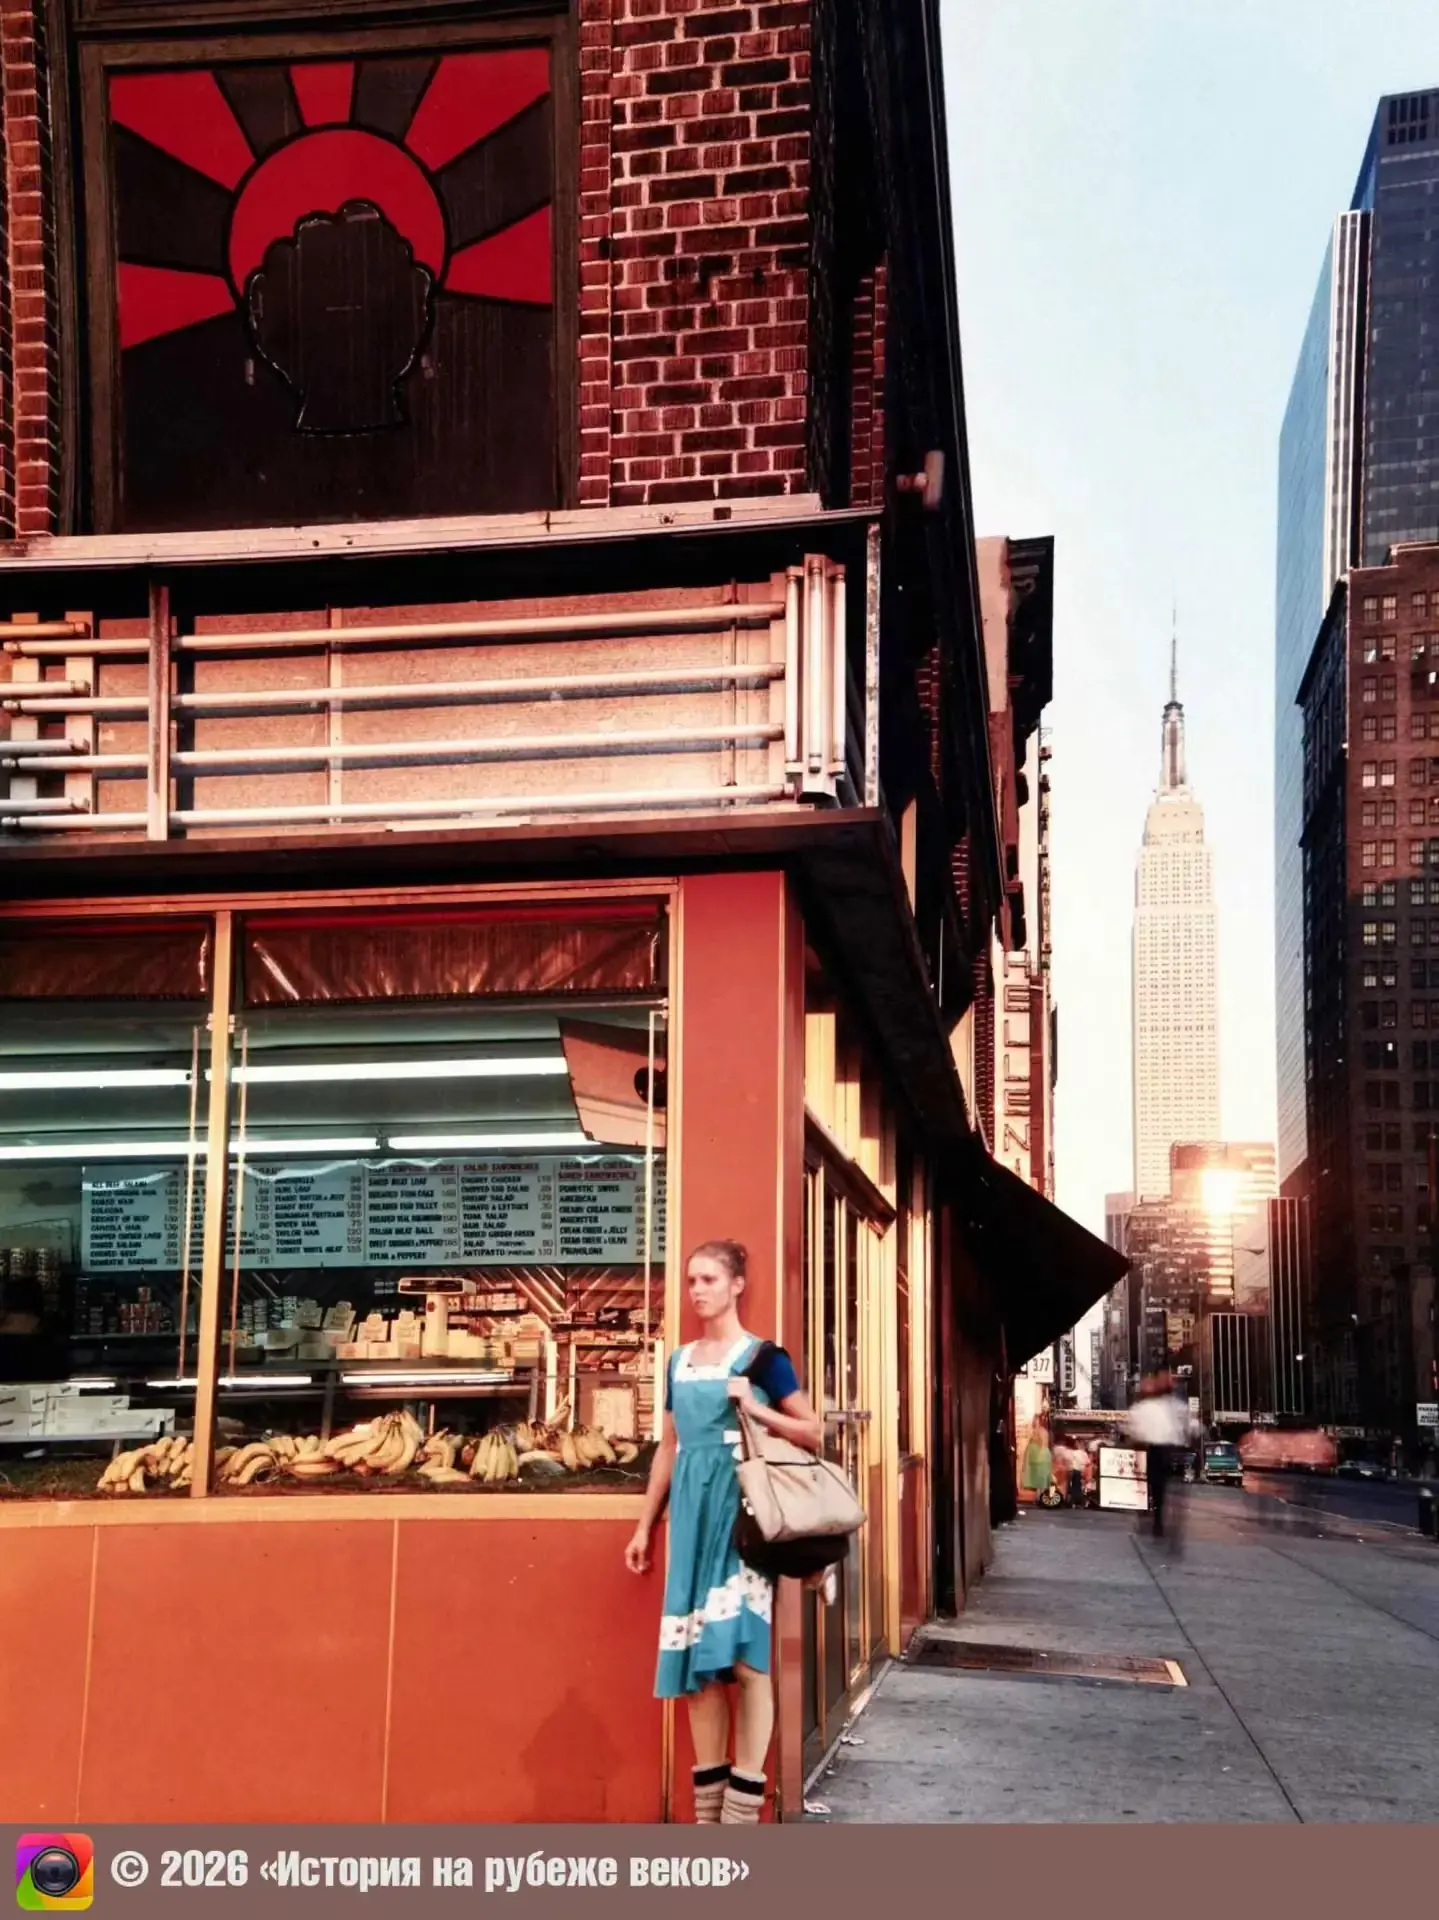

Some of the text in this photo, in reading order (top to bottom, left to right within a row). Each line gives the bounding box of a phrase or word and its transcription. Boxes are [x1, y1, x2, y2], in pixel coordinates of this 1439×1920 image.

[485, 1212, 509, 1220] SALAD
[482, 1221, 507, 1230] SALAD
[463, 1239, 485, 1248] SALAD
[463, 1248, 506, 1257] ANTIPASTO
